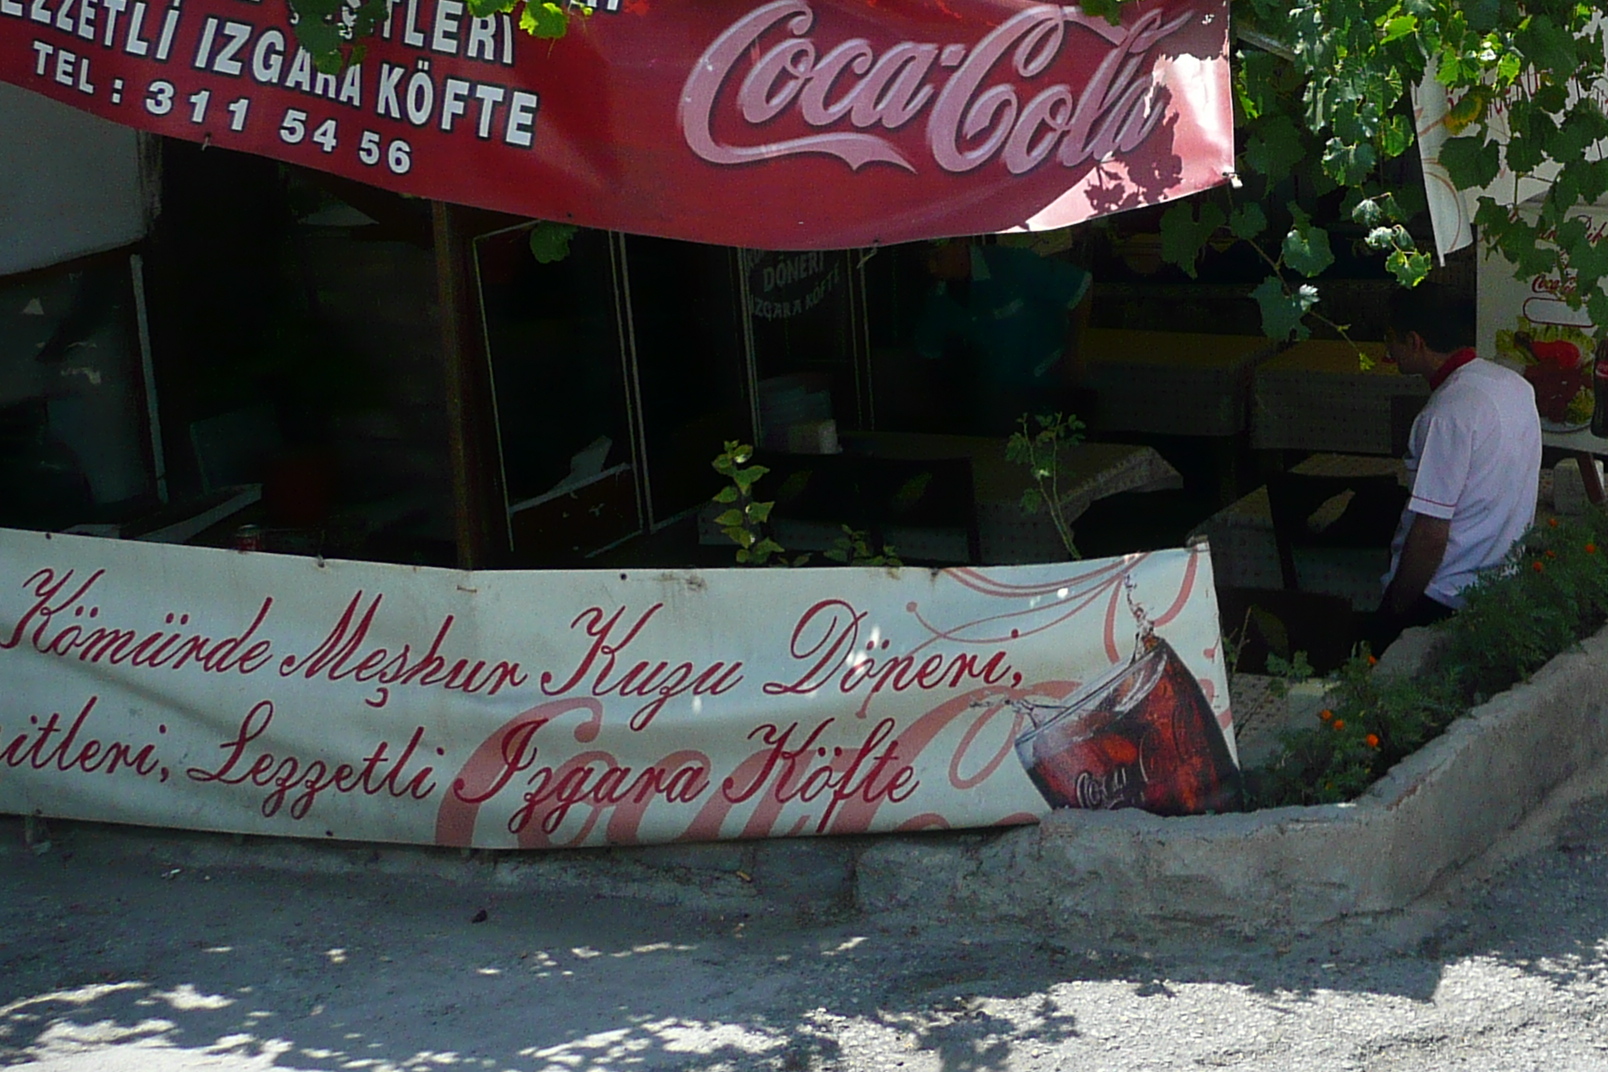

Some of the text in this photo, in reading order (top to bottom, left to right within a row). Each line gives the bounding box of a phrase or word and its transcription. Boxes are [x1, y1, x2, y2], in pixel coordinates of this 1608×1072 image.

[145, 79, 249, 131] 311
[279, 108, 338, 154] 54
[358, 131, 412, 175] 56
[376, 59, 539, 150] KÖFTE
[2, 568, 272, 676] Kömürde
[280, 589, 528, 707] Meşhur
[541, 602, 743, 731] Kuzu
[187, 700, 443, 819] Lezzetli
[722, 717, 920, 833] Köfte
